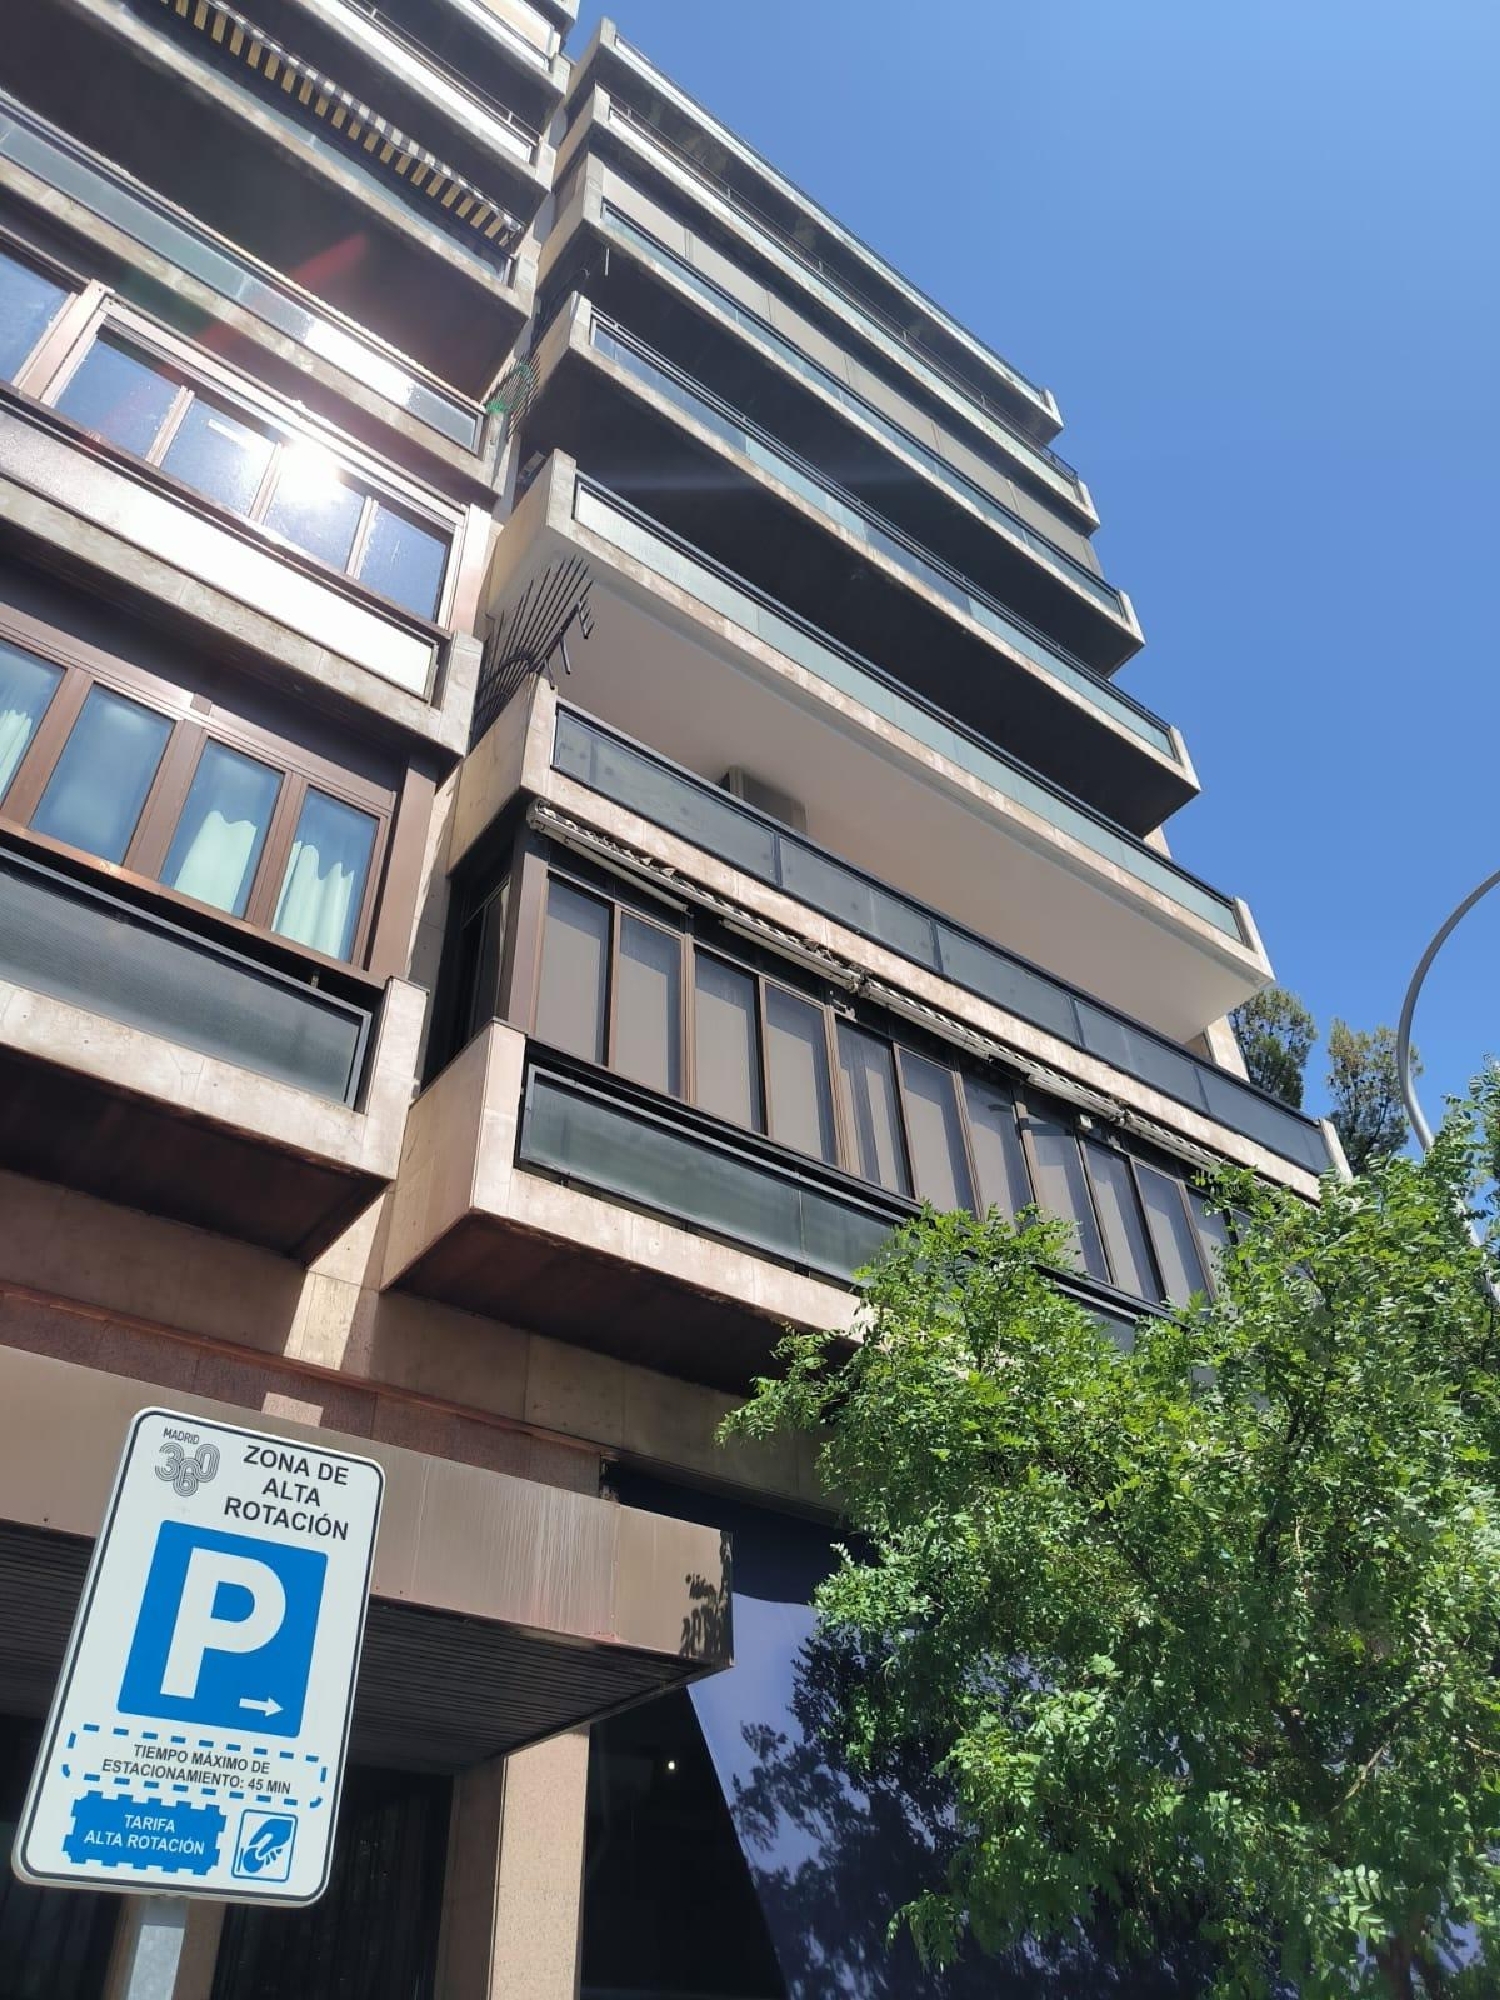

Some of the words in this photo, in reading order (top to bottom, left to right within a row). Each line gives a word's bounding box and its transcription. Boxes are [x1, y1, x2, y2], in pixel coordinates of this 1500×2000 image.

[163, 1427, 200, 1445] MADRID
[155, 1442, 220, 1497] 360
[243, 1445, 310, 1476] ZONA
[318, 1463, 349, 1485] DE
[262, 1478, 320, 1506] ALTA
[224, 1496, 349, 1540] ROTACIÓN
[160, 1548, 286, 1699] P
[102, 1758, 245, 1789] ESTACIONAMIENTO:
[247, 1778, 264, 1791] 45
[267, 1780, 291, 1795] MIN
[133, 1744, 189, 1764] TIEMPO
[191, 1751, 248, 1772] MÁXIMO
[251, 1760, 271, 1775] DE
[124, 1814, 175, 1833] TARIFA
[83, 1829, 122, 1846] ALTA
[127, 1835, 205, 1855] ROTACIÓN
